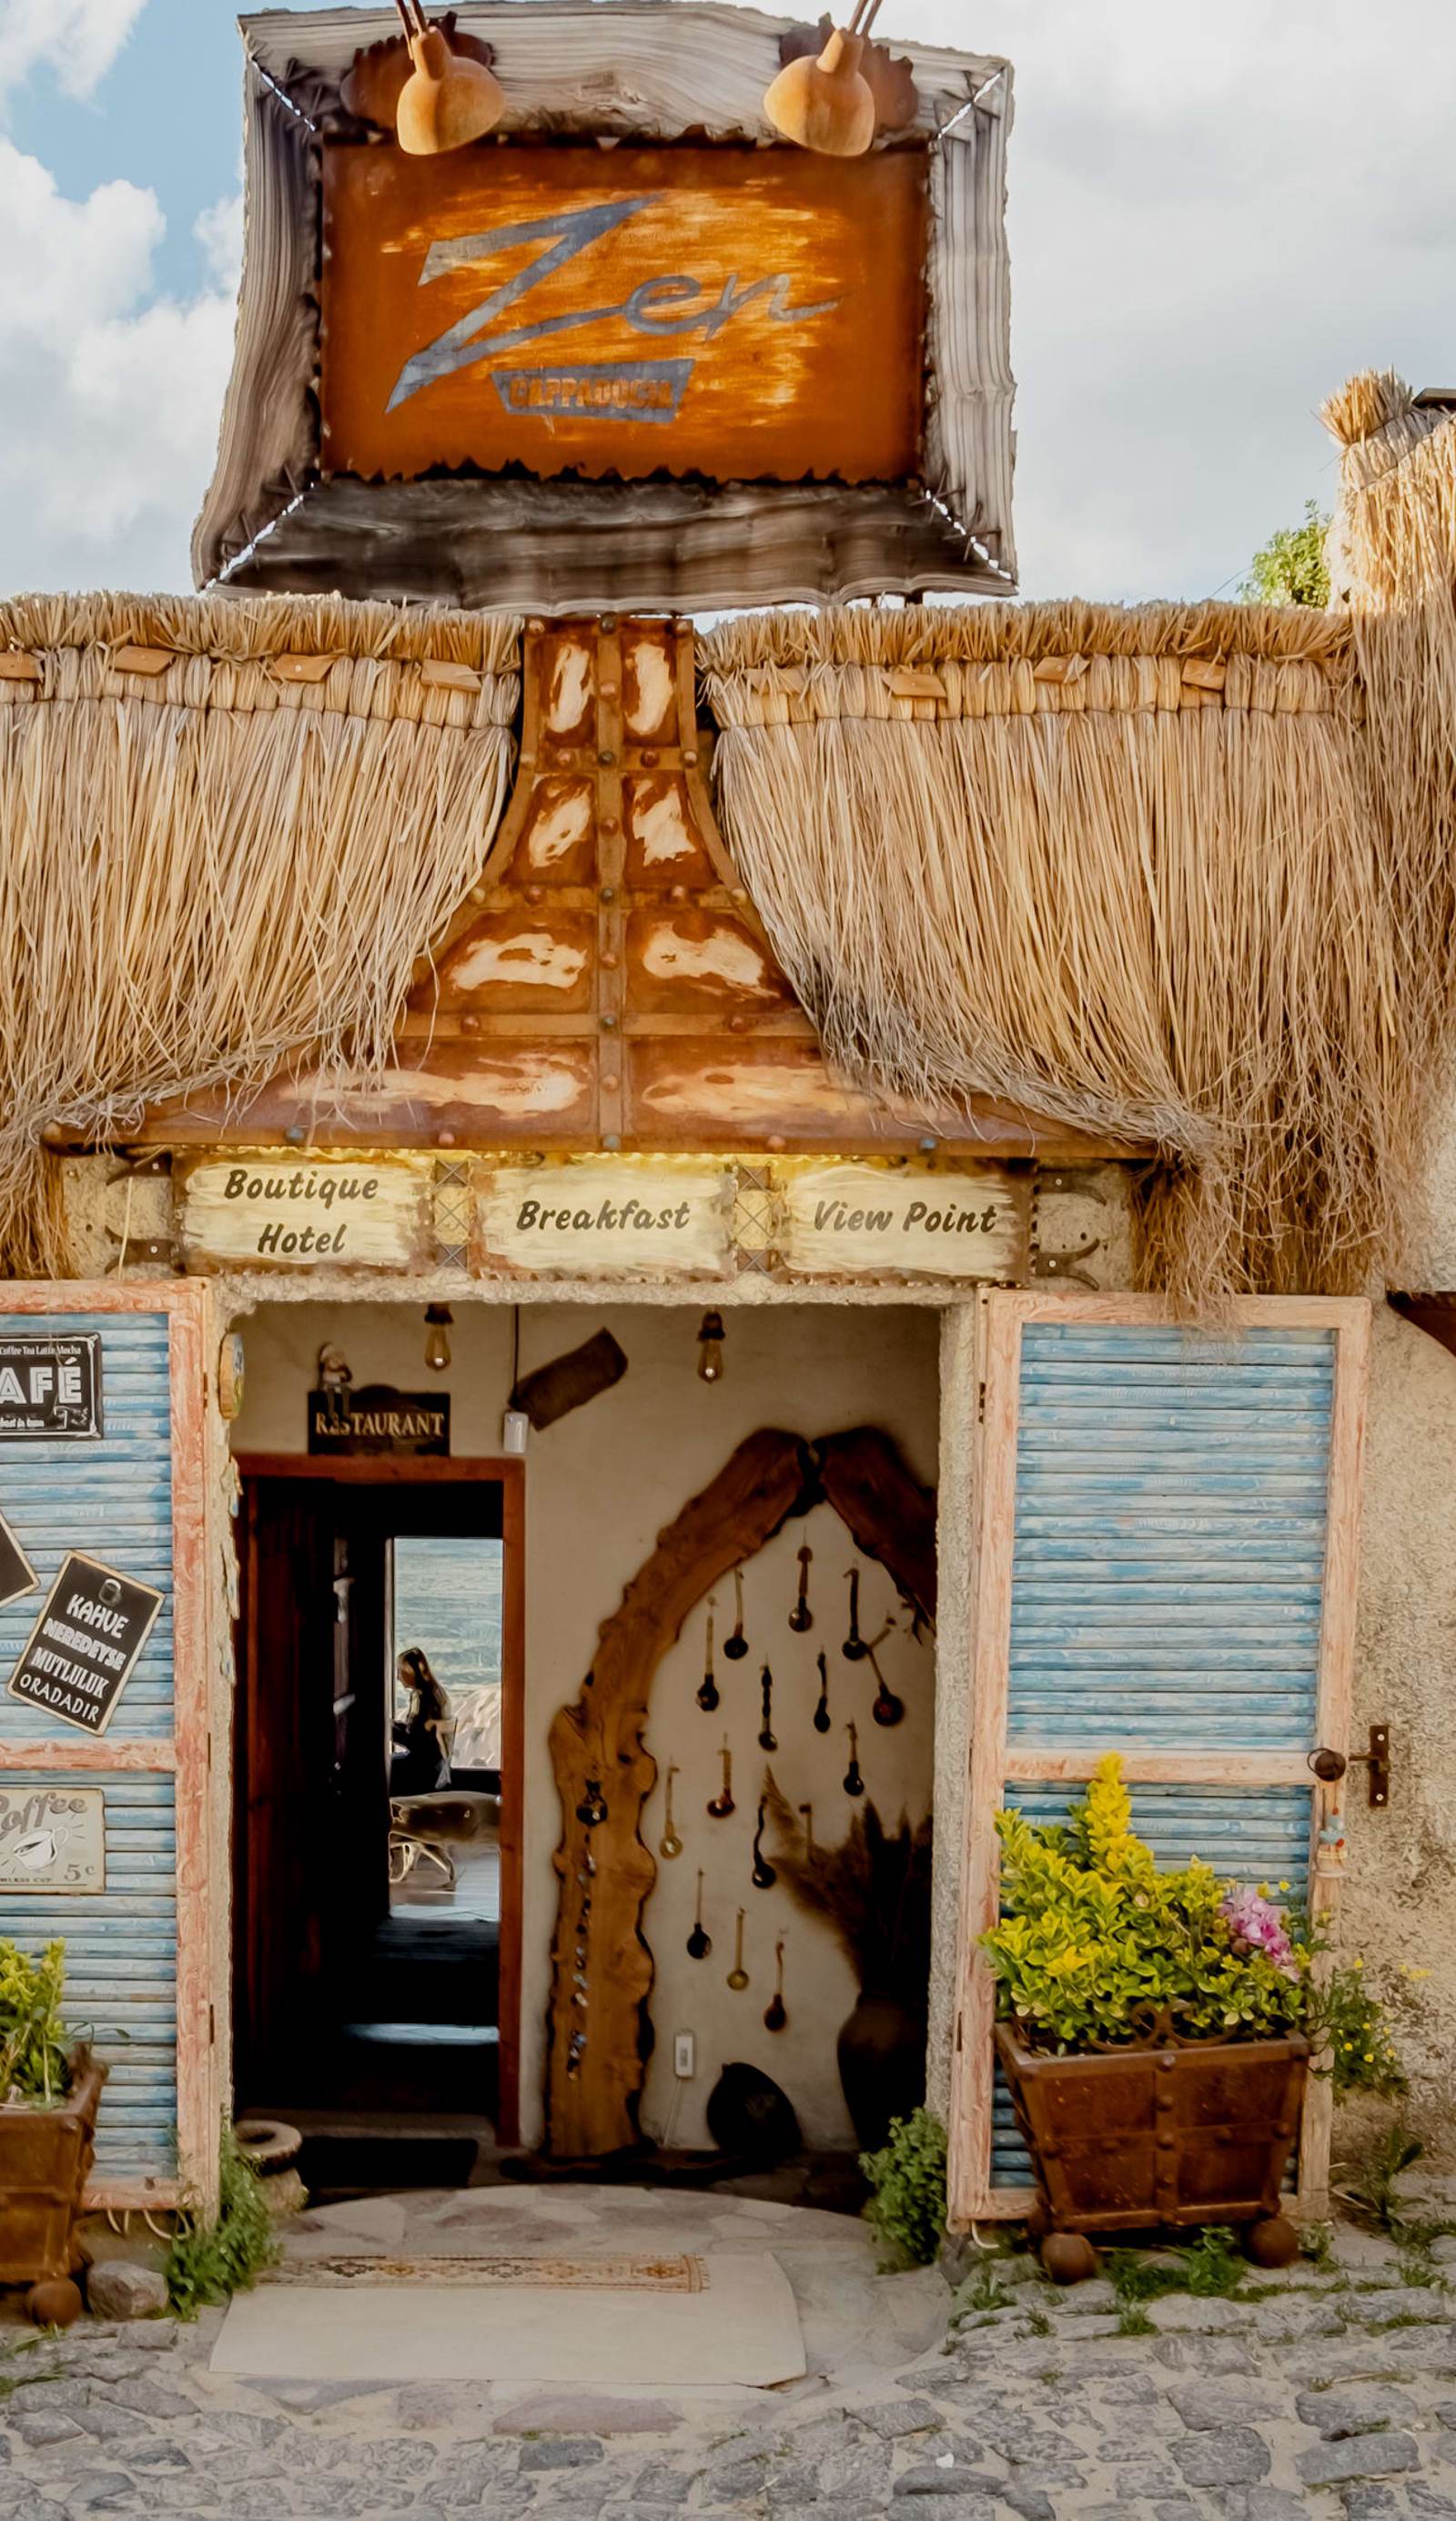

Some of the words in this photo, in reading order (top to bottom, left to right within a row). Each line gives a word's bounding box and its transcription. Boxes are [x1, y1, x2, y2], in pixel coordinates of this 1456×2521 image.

[385, 190, 846, 415] Zen
[224, 1169, 379, 1210] Boutique
[516, 1199, 691, 1230] Breakfast
[814, 1200, 894, 1231] View
[903, 1201, 997, 1233] Point
[257, 1223, 348, 1253] Hotel
[66, 1594, 130, 1638] KAHVE
[43, 1617, 127, 1671] NEREDEYSE
[31, 1646, 110, 1699] MUTLULUK
[20, 1674, 100, 1723] ORADADIR
